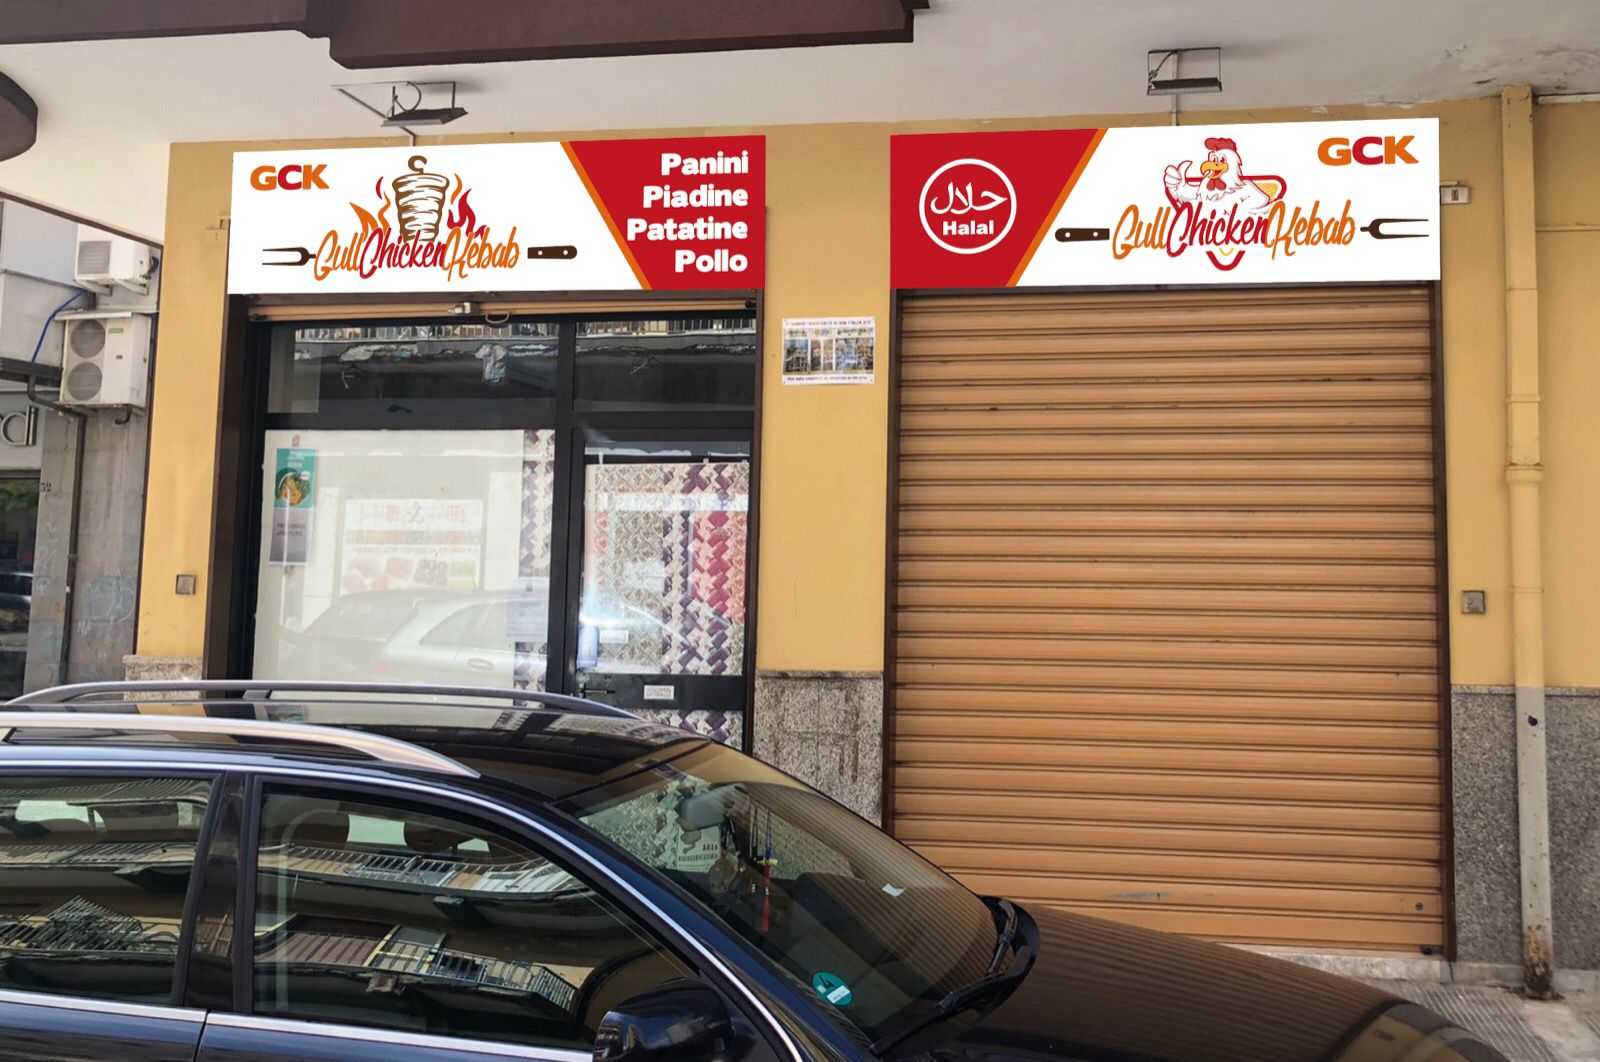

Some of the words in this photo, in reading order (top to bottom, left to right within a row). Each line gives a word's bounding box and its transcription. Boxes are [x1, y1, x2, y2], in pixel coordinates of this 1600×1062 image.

[661, 150, 749, 176] Panini
[1317, 136, 1419, 166] GCK
[250, 164, 330, 191] GCK
[643, 183, 749, 208] Piadine
[930, 181, 1008, 215] حلال
[626, 215, 749, 241] Patatine
[942, 219, 994, 236] Halal
[674, 249, 749, 272] Pollo
